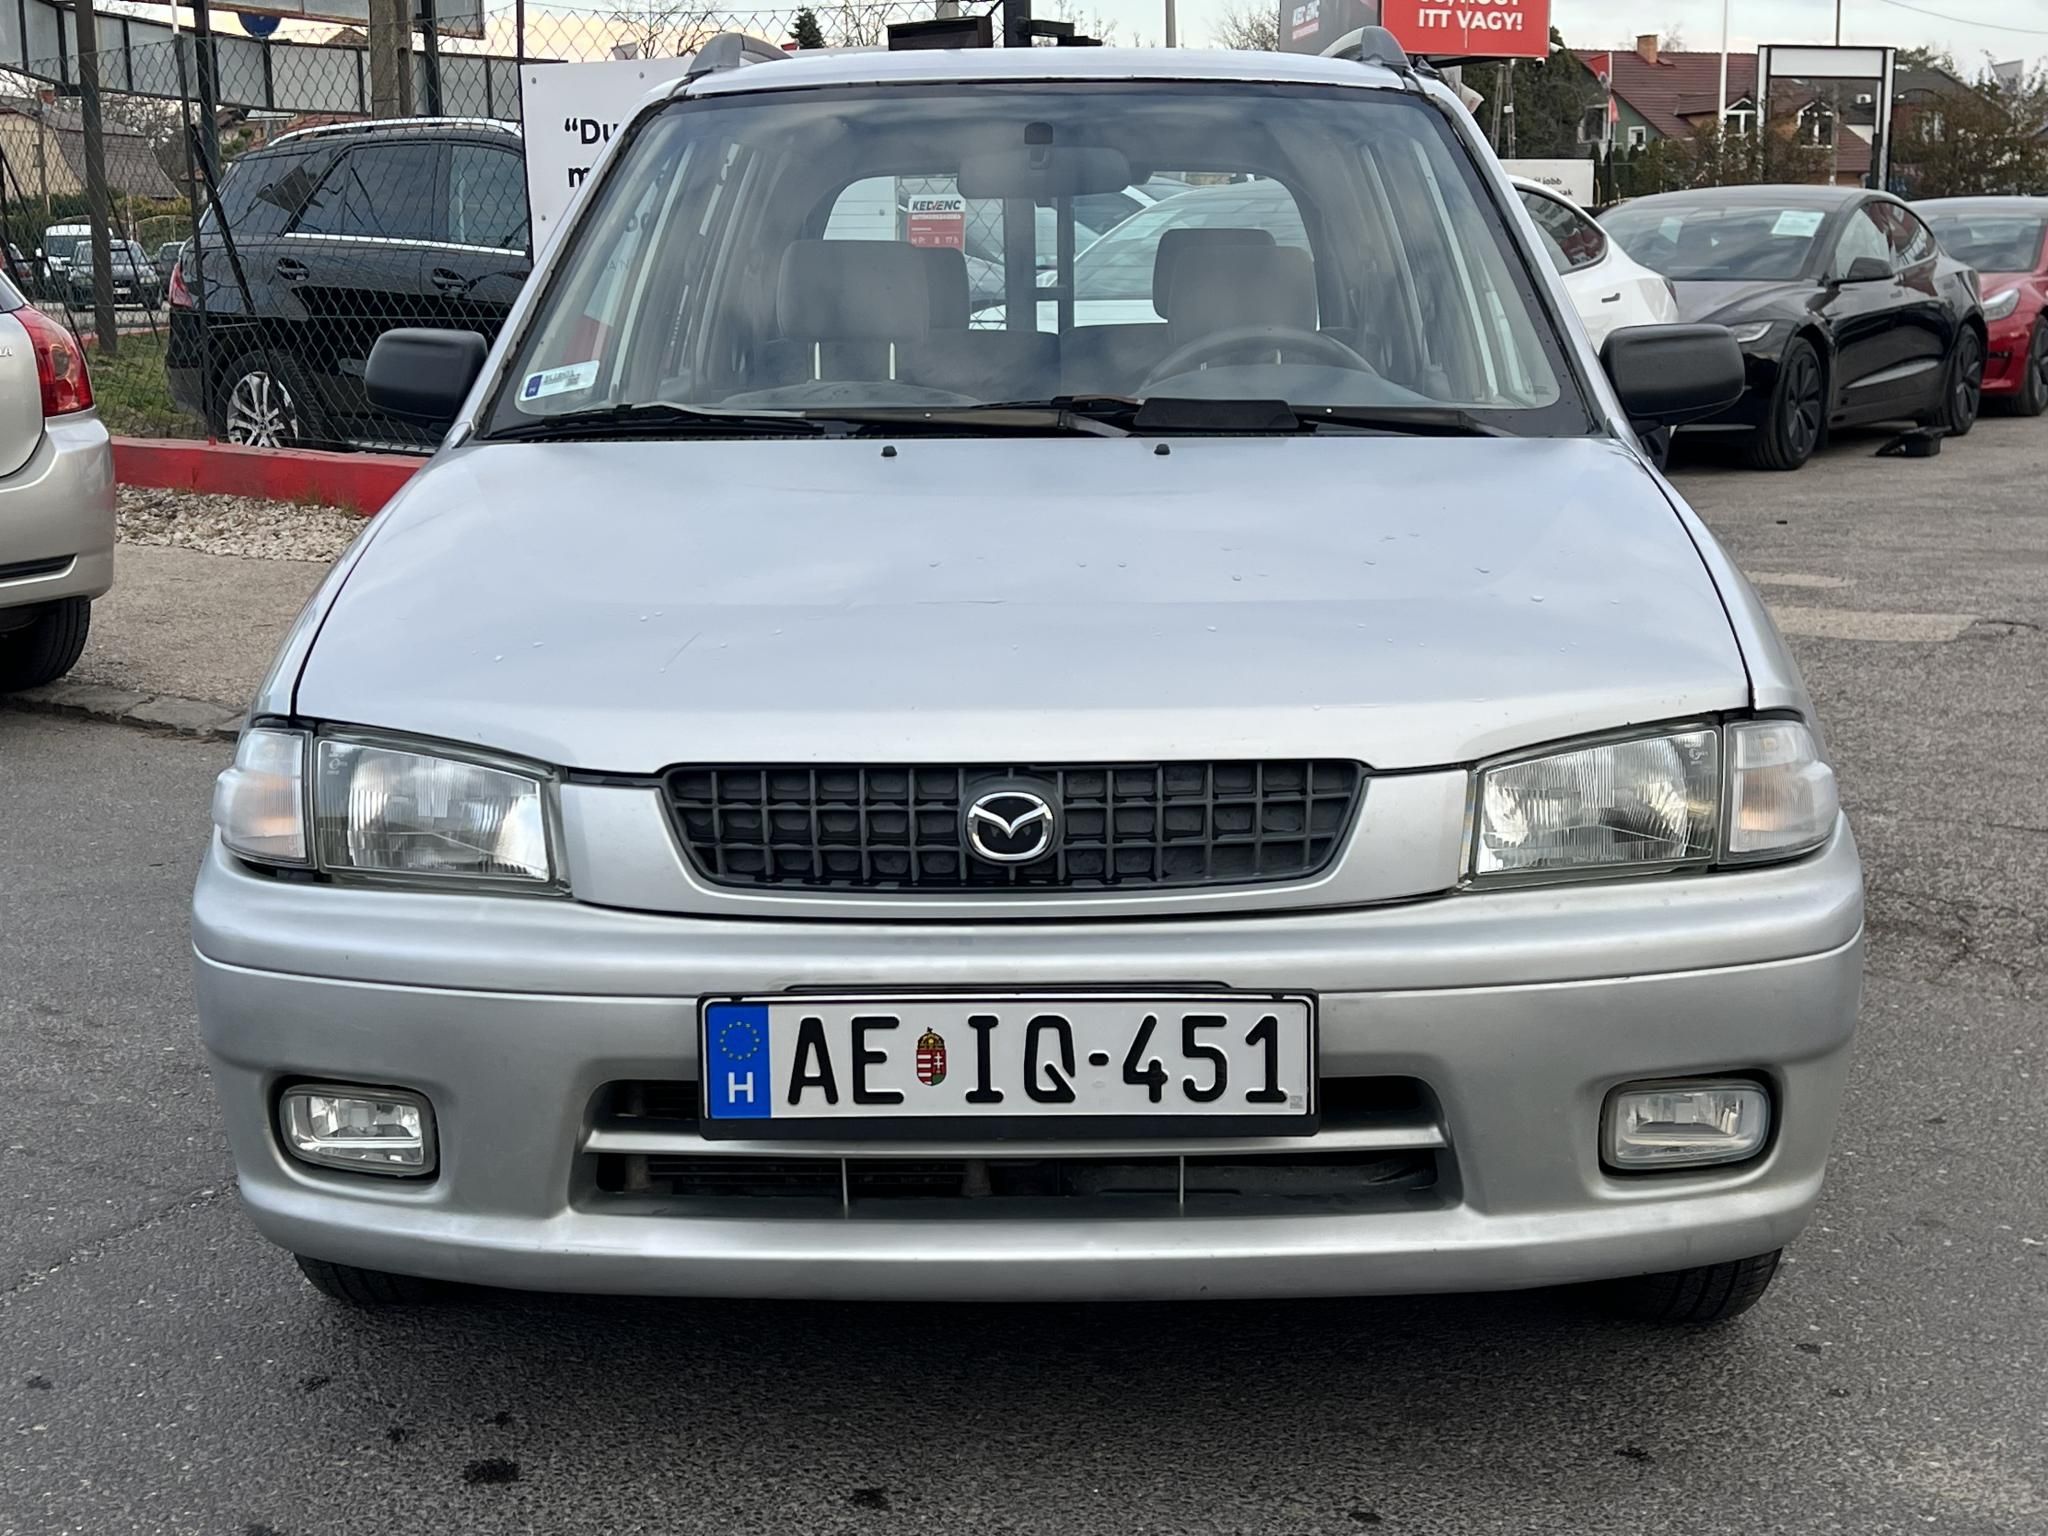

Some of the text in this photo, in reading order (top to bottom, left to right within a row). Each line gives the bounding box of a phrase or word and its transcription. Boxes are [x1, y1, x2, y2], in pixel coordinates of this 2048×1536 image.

[1418, 8, 1523, 31] ITT VAGY!
[787, 1014, 1289, 1105] AE IQ-451
[727, 1071, 754, 1104] H
